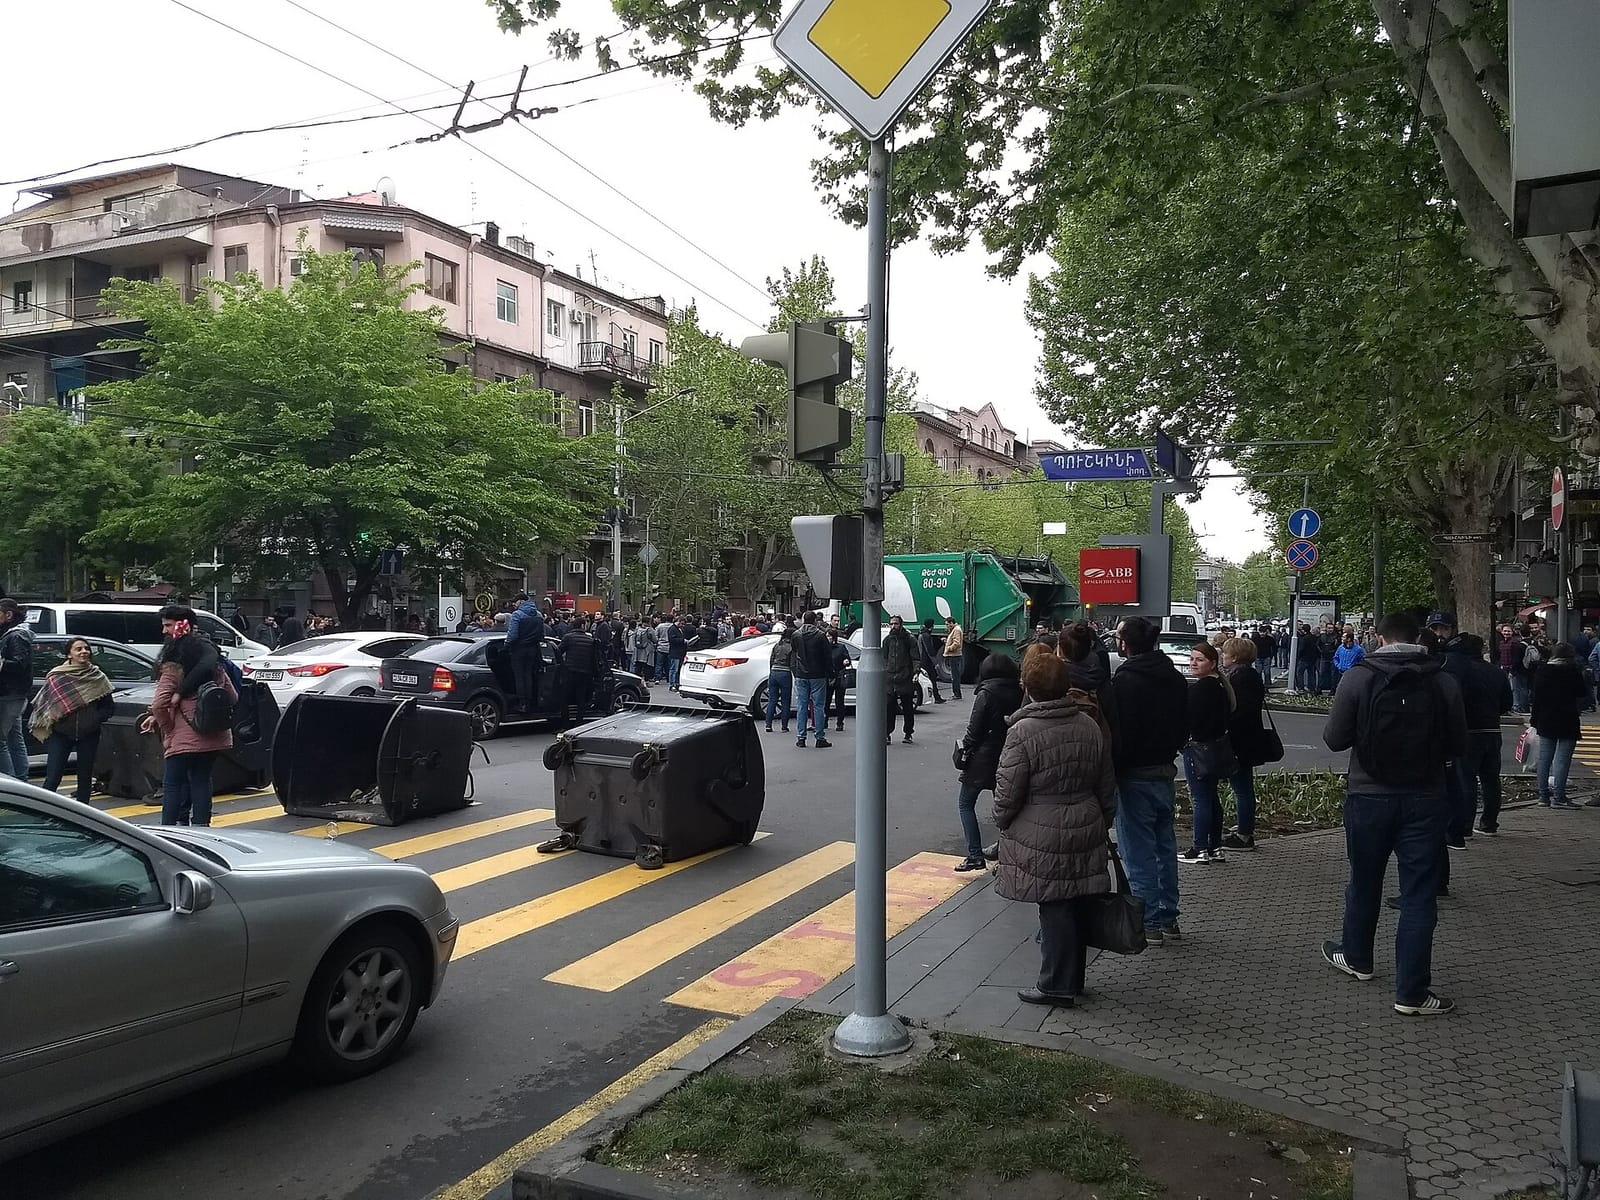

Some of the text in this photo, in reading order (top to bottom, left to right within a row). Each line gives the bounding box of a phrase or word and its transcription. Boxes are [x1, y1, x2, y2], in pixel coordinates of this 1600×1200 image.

[1054, 453, 1135, 469] ՊՈՒՇԿԻՆԻ
[1106, 567, 1133, 577] ABB
[922, 578, 947, 589] 80-90
[1186, 617, 1194, 625] 70
